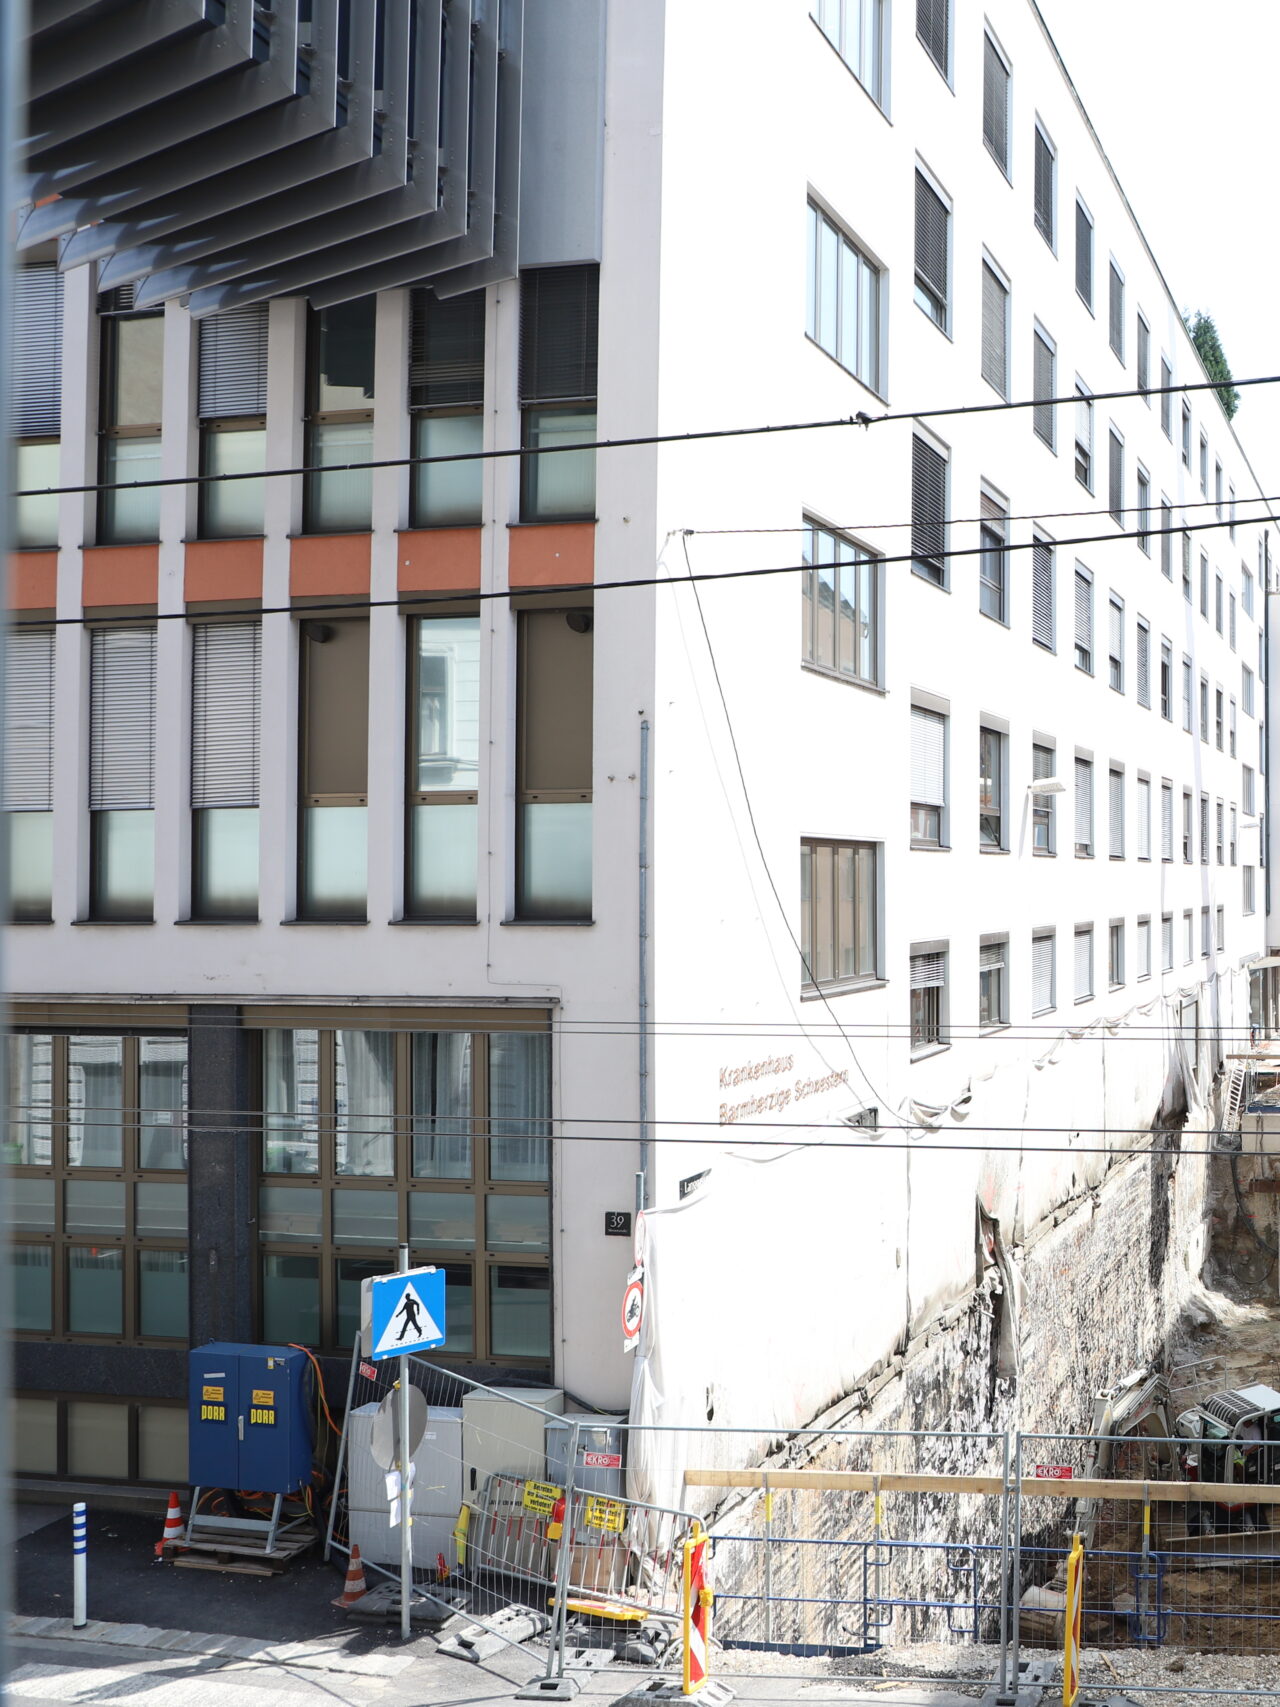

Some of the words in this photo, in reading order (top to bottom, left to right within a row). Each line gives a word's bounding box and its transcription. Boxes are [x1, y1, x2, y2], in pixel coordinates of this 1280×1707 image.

[719, 1053, 794, 1090] Krankenhaus
[719, 1086, 792, 1127] Barmherzige
[794, 1069, 849, 1102] Schwestern
[610, 1215, 625, 1228] 39
[587, 1455, 609, 1465] EKRO
[1038, 1467, 1060, 1477] EKRO
[533, 1483, 553, 1493] Betreten
[530, 1499, 552, 1508] verboten!
